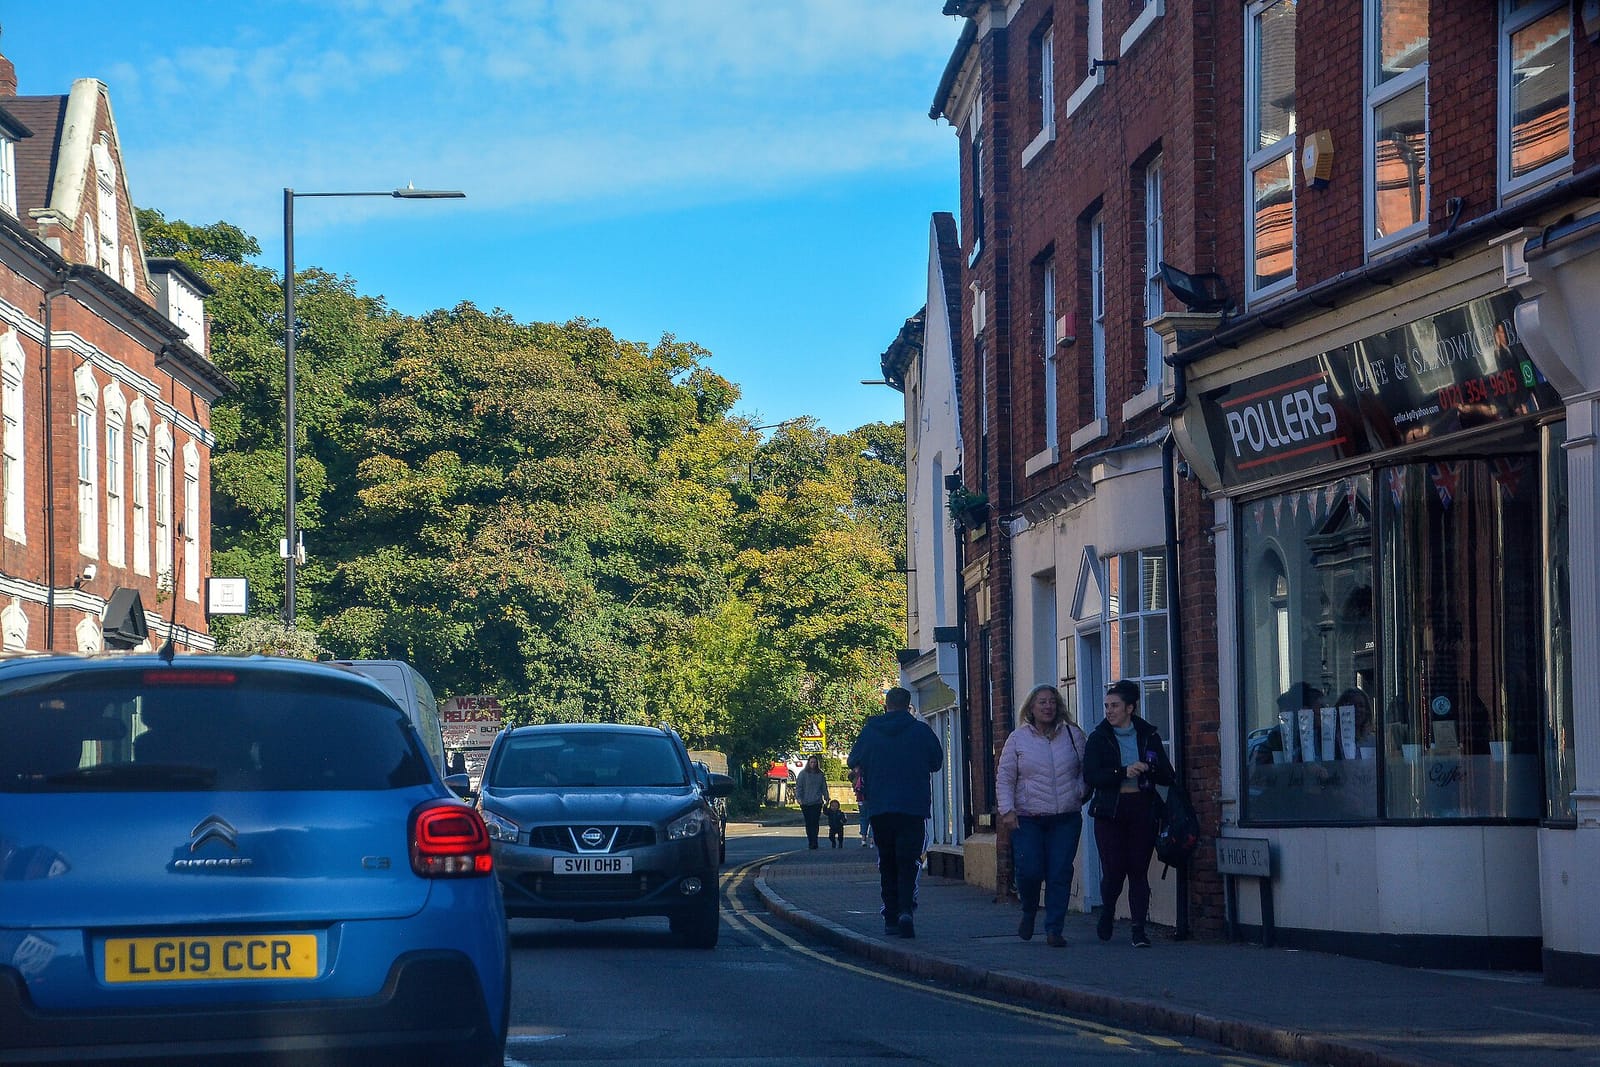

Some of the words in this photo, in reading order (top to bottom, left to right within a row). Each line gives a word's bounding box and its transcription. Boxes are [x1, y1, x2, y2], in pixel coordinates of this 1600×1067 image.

[1393, 353, 1409, 381] &
[1439, 387, 1465, 411] 0121
[1464, 378, 1488, 403] 354
[1488, 368, 1518, 397] 9615
[1226, 383, 1338, 457] POLLERS
[456, 697, 476, 709] WE
[361, 855, 391, 870] C3
[594, 858, 622, 872] OHB
[1227, 847, 1248, 865] HIGH
[128, 941, 211, 975] LG19
[222, 940, 291, 971] CCR
